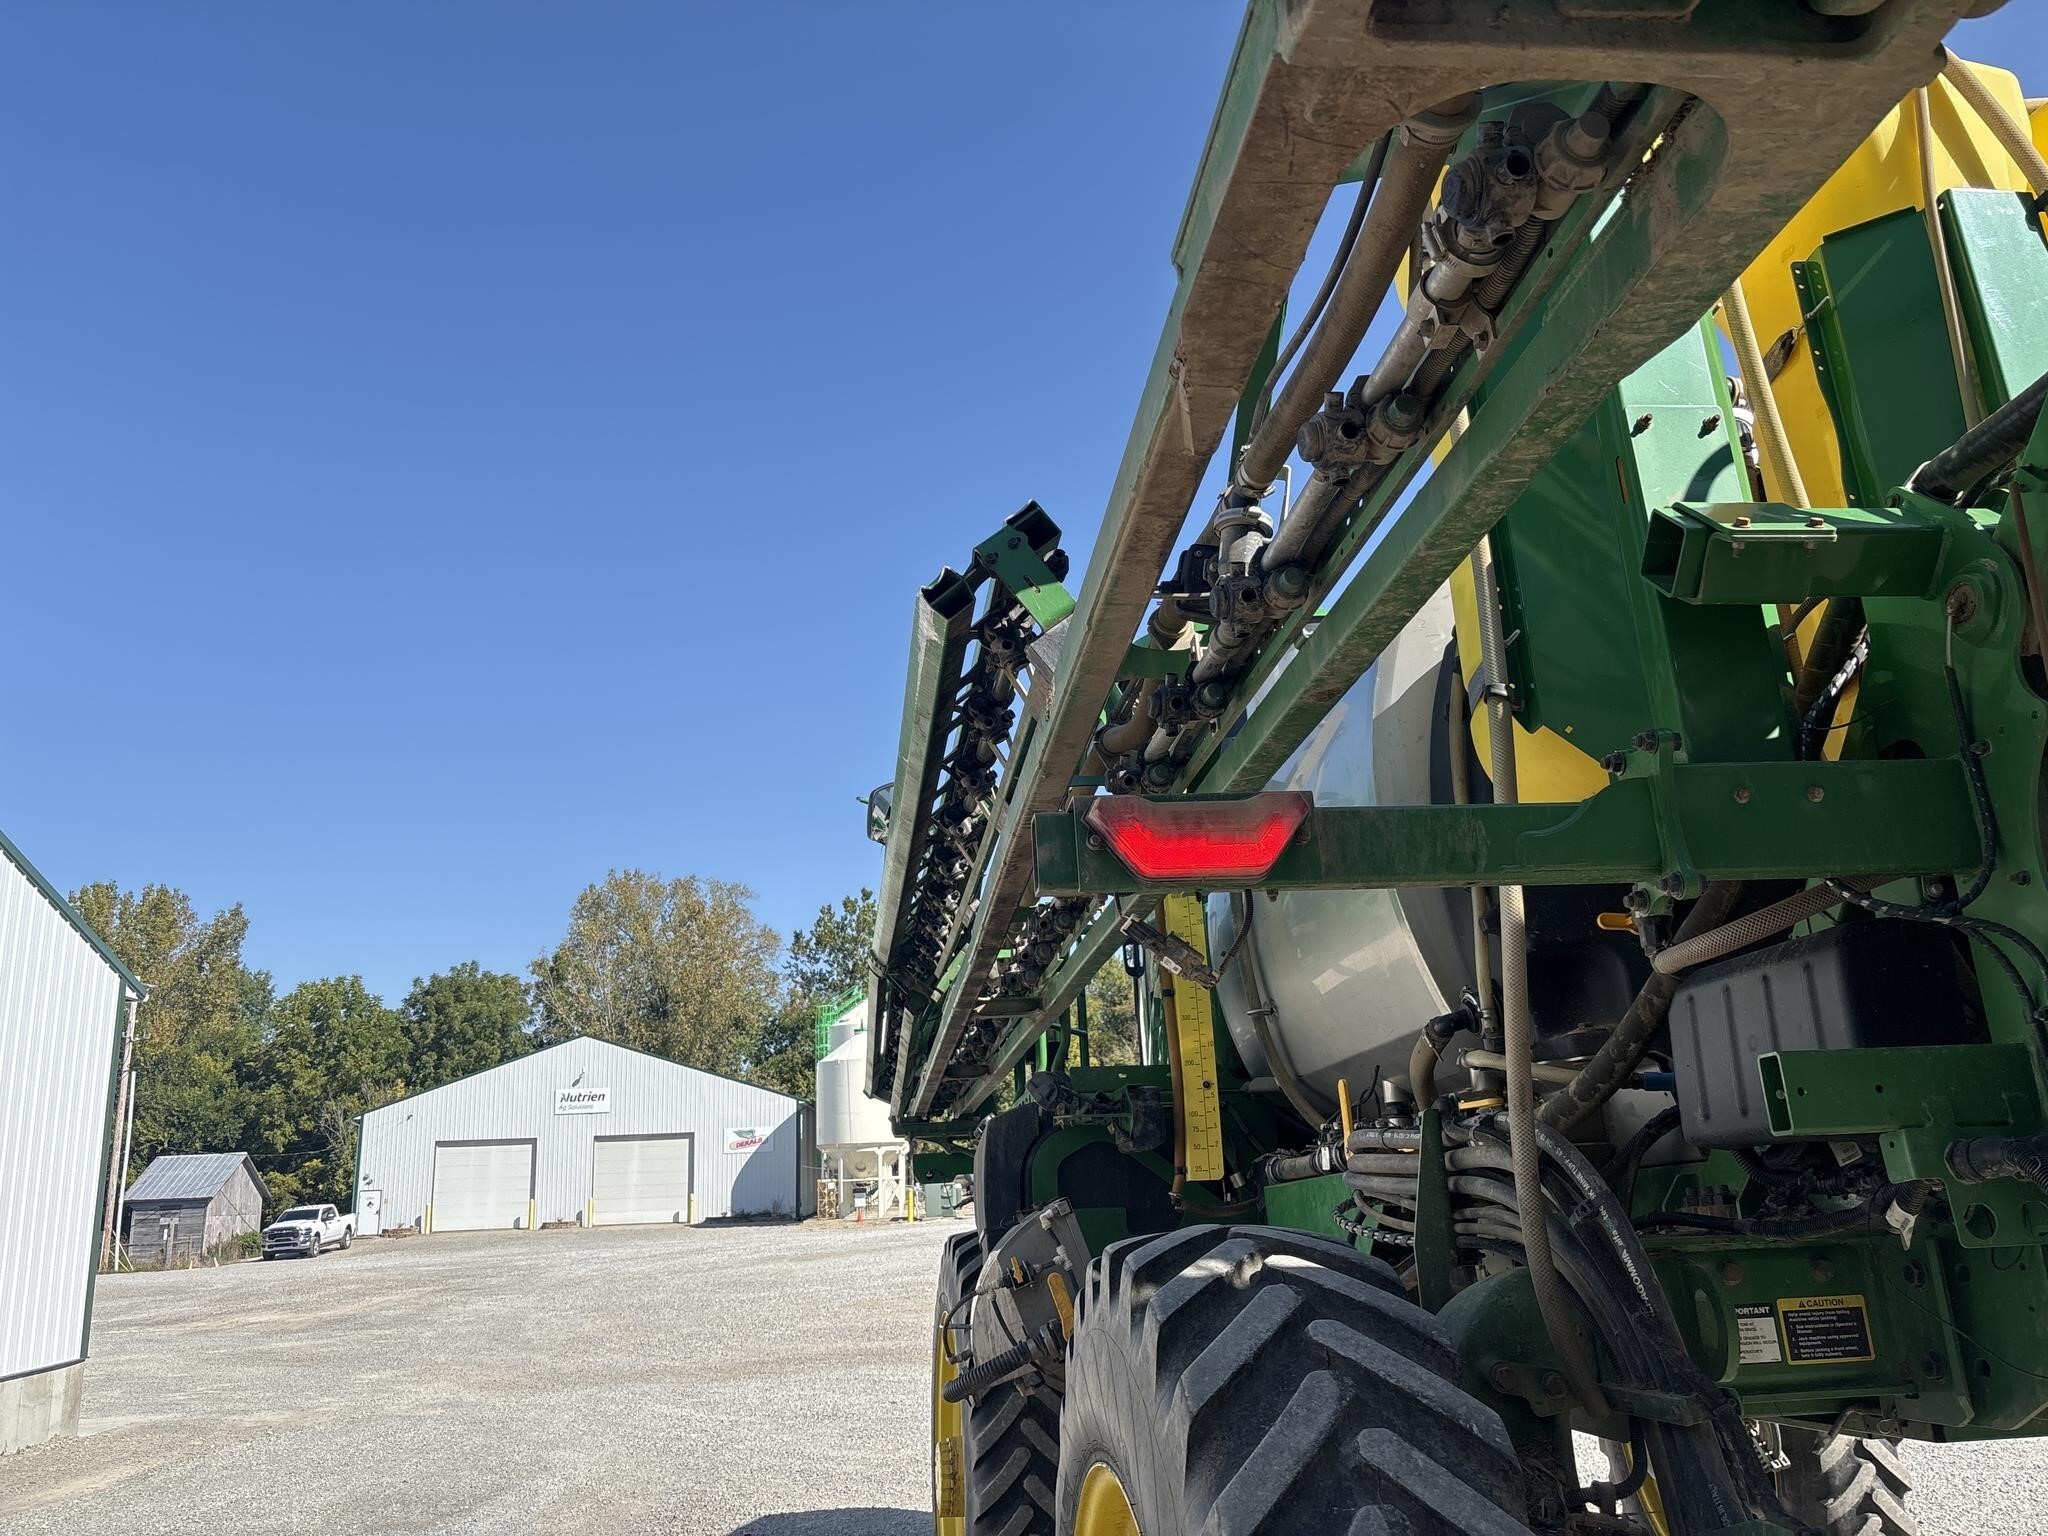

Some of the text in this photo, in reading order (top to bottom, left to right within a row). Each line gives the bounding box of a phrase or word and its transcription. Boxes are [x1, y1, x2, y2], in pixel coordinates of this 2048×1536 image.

[560, 1090, 606, 1103] Nutrien
[558, 1103, 594, 1112] Ag Solutions
[735, 1136, 769, 1149] DEKALB
[1193, 1143, 1200, 1151] 50
[1194, 1165, 1202, 1173] 25
[1563, 1157, 1591, 1191] MINETUFF
[1806, 1298, 1844, 1308] CAUTION
